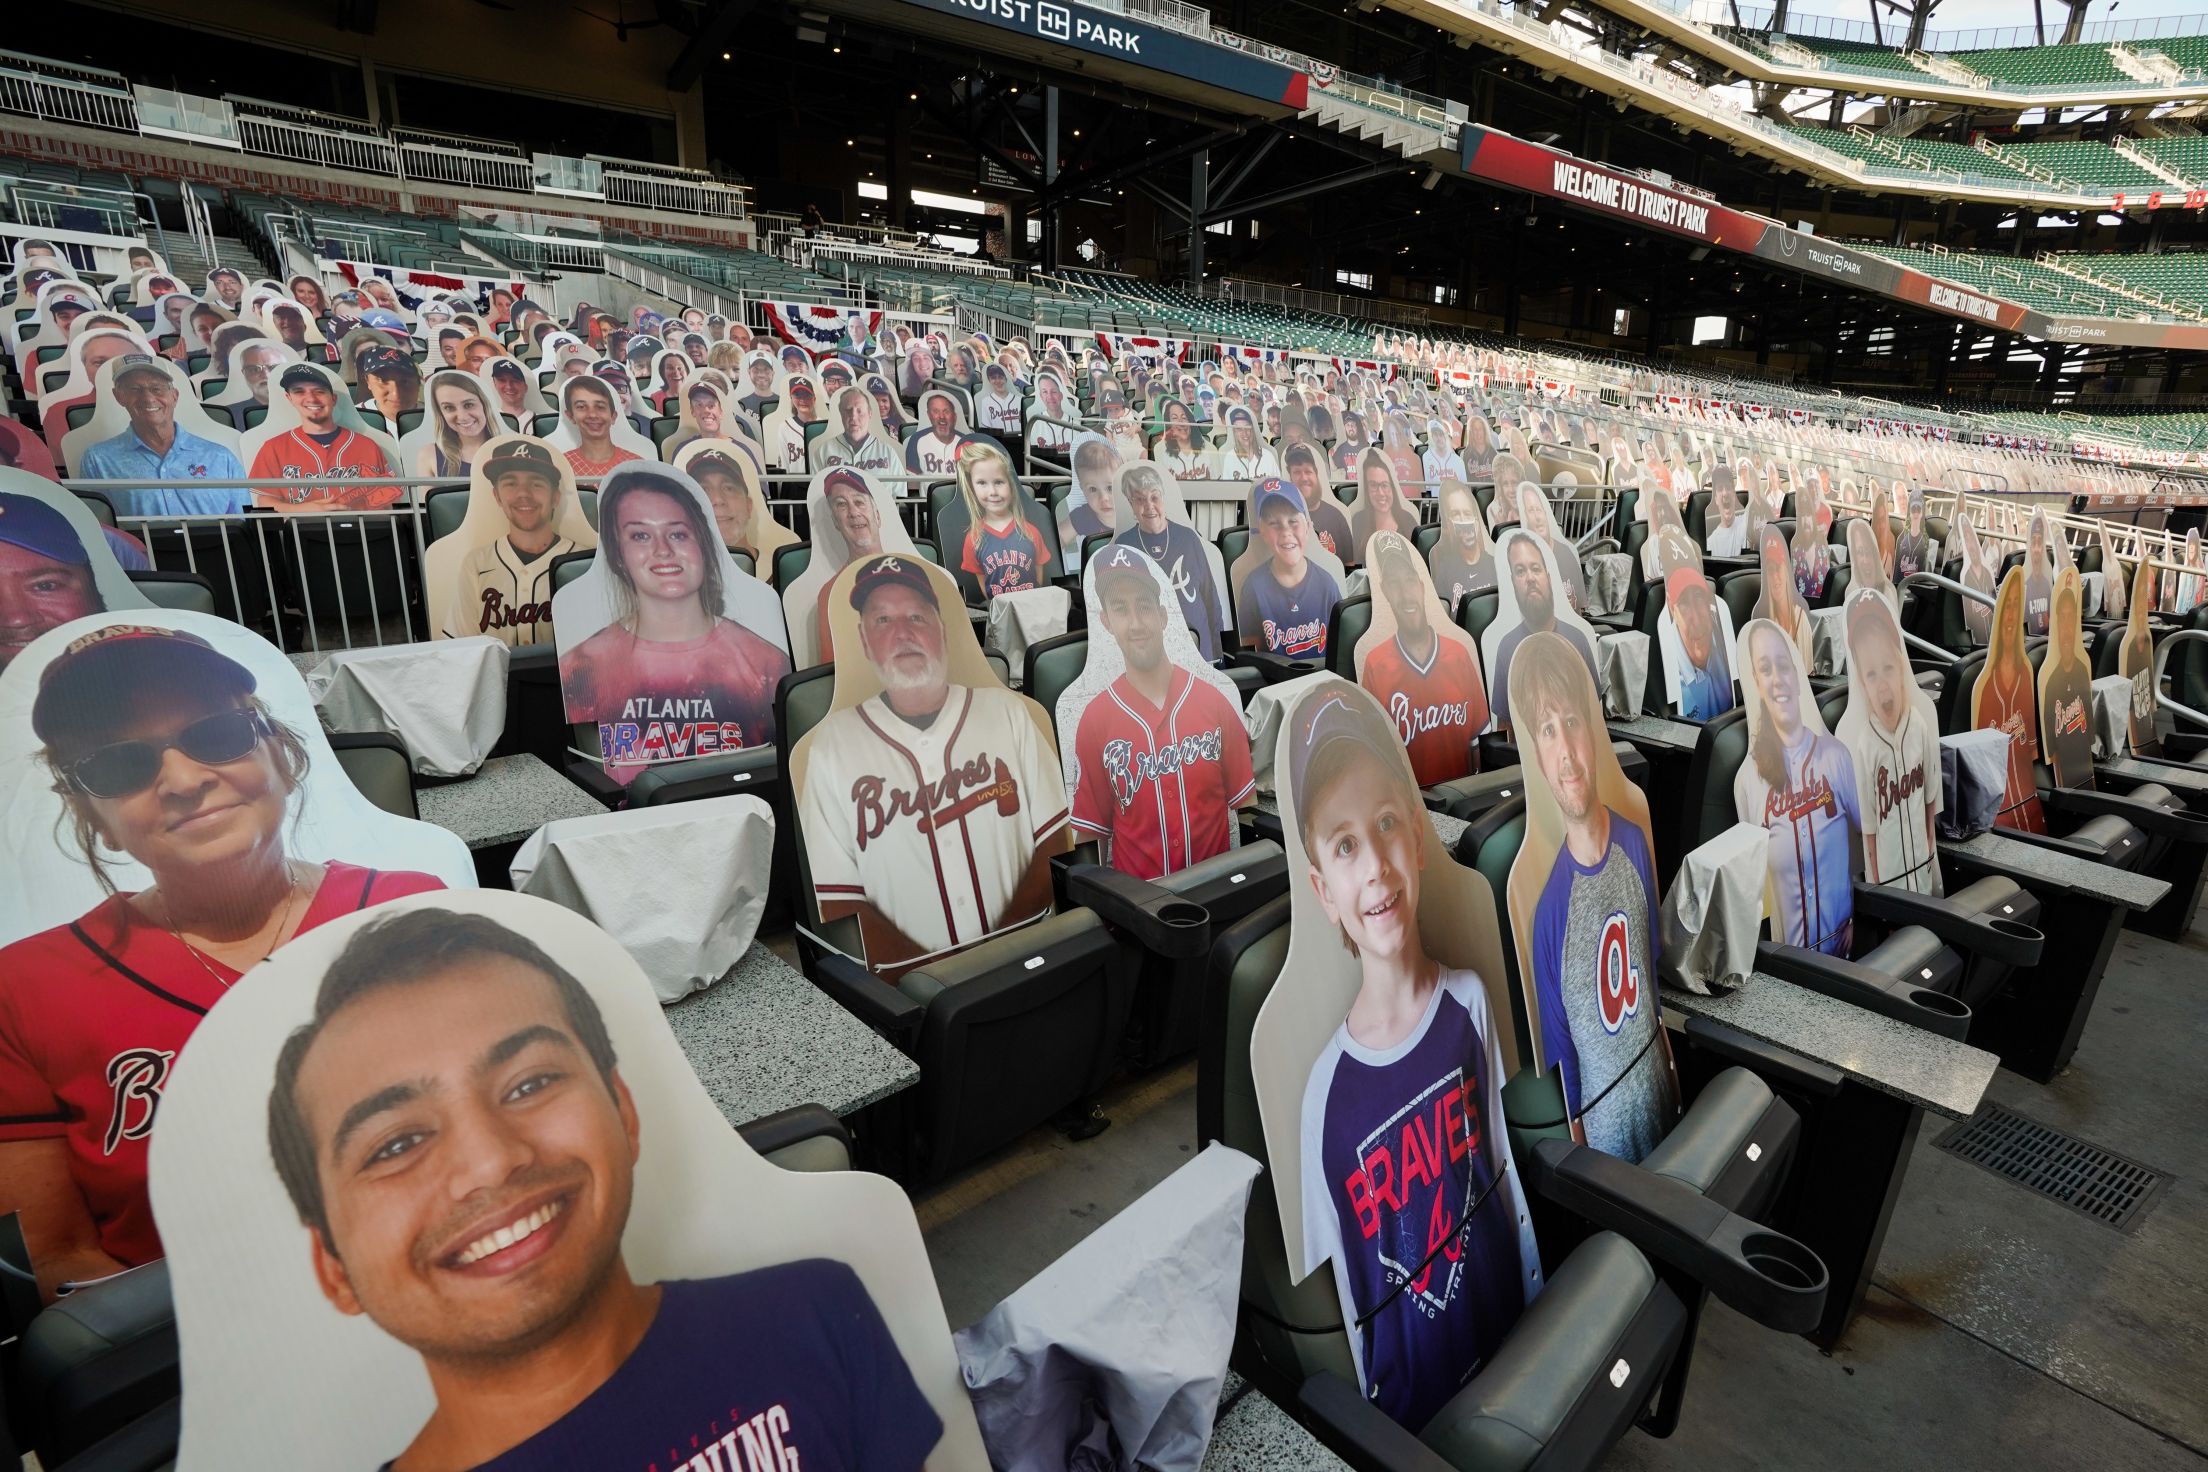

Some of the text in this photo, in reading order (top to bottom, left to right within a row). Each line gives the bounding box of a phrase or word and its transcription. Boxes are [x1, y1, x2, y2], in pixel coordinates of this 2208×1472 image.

[1077, 19, 1140, 53] PARK
[1553, 160, 1709, 234] WELCOME TO TRUIST PARK
[2147, 191, 2164, 210] 6
[2182, 189, 2208, 209] 10
[1808, 249, 1862, 275] TRUIST PARK
[1929, 283, 2000, 322] WELCOME TO TRUIST PARK
[2082, 328, 2107, 337] PARK
[512, 444, 529, 458] A
[872, 557, 901, 574] A
[985, 549, 1033, 575] ATLANTA
[1110, 548, 1131, 567] A
[1169, 554, 1197, 603] A
[69, 625, 174, 655] BRAVES
[1263, 618, 1320, 651] Braves
[622, 698, 715, 719] ATLANTA
[1390, 691, 1469, 746] Braves
[599, 722, 743, 763] BRAVES
[1103, 727, 1221, 815] Braves
[852, 752, 991, 852] Braves
[1344, 1076, 1481, 1240] BRAVES
[1450, 1191, 1477, 1302] TRAINIG
[1385, 1272, 1436, 1320] SPRING
